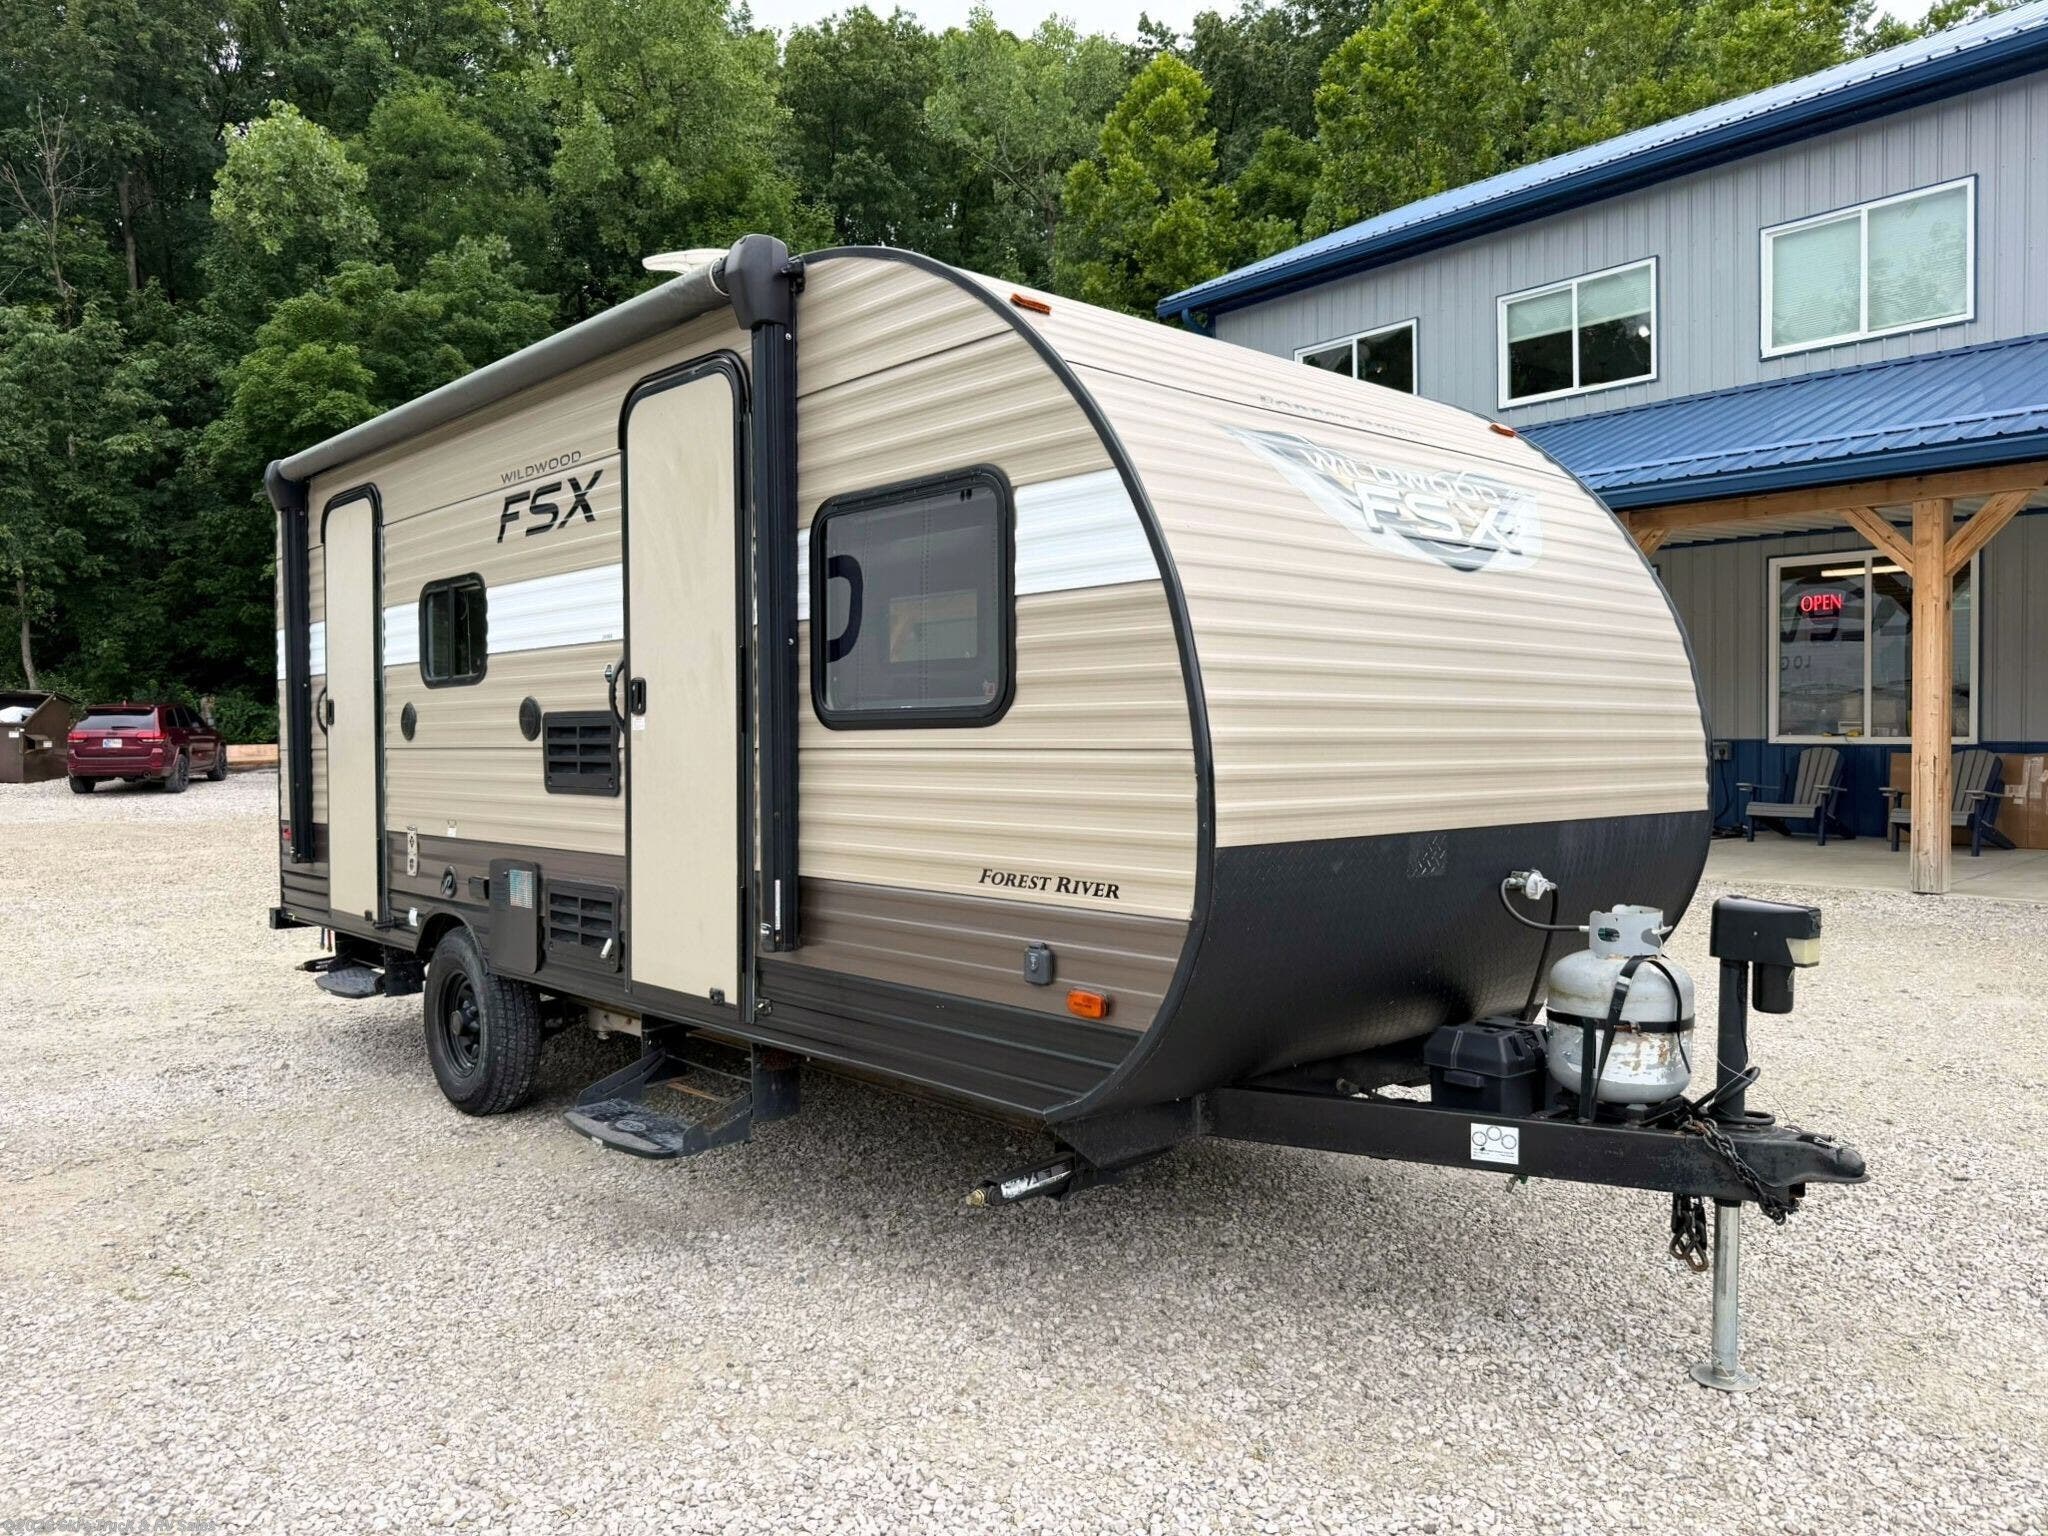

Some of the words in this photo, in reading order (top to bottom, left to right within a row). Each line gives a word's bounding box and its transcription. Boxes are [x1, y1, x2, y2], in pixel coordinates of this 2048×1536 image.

[500, 450, 582, 484] WILDWOOD
[1299, 449, 1499, 504] WILDWOOD
[497, 469, 604, 544] FSX
[1353, 481, 1522, 555] FSX
[1800, 593, 1842, 612] OPEN
[978, 868, 1051, 891] FOREST
[1055, 876, 1120, 900] RIVER
